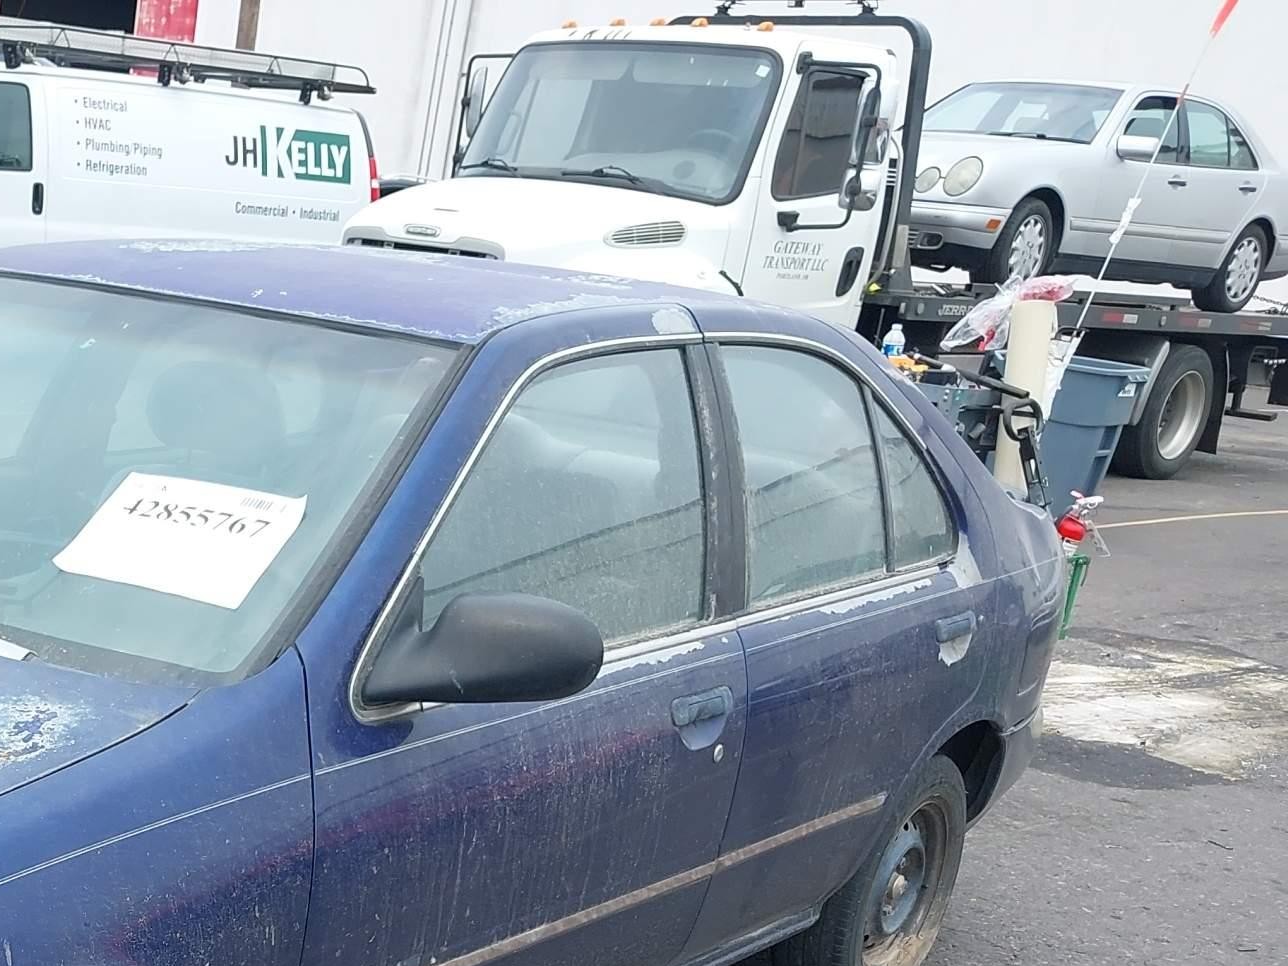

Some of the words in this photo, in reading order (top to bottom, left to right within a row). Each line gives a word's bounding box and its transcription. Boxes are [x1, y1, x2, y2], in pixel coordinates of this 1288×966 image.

[83, 96, 127, 112] Electrical
[84, 116, 112, 131] HVAC
[85, 137, 163, 160] Plumbing/Piping
[225, 135, 258, 169] JH
[263, 125, 350, 182] KELLY
[85, 159, 148, 177] Refrigeration
[234, 201, 289, 218] Commercial
[299, 207, 341, 222] Industrial
[774, 240, 823, 256] GATEWAY
[763, 255, 812, 271] TRANSPORT
[810, 258, 829, 272] LLC
[123, 498, 271, 538] 42855767
